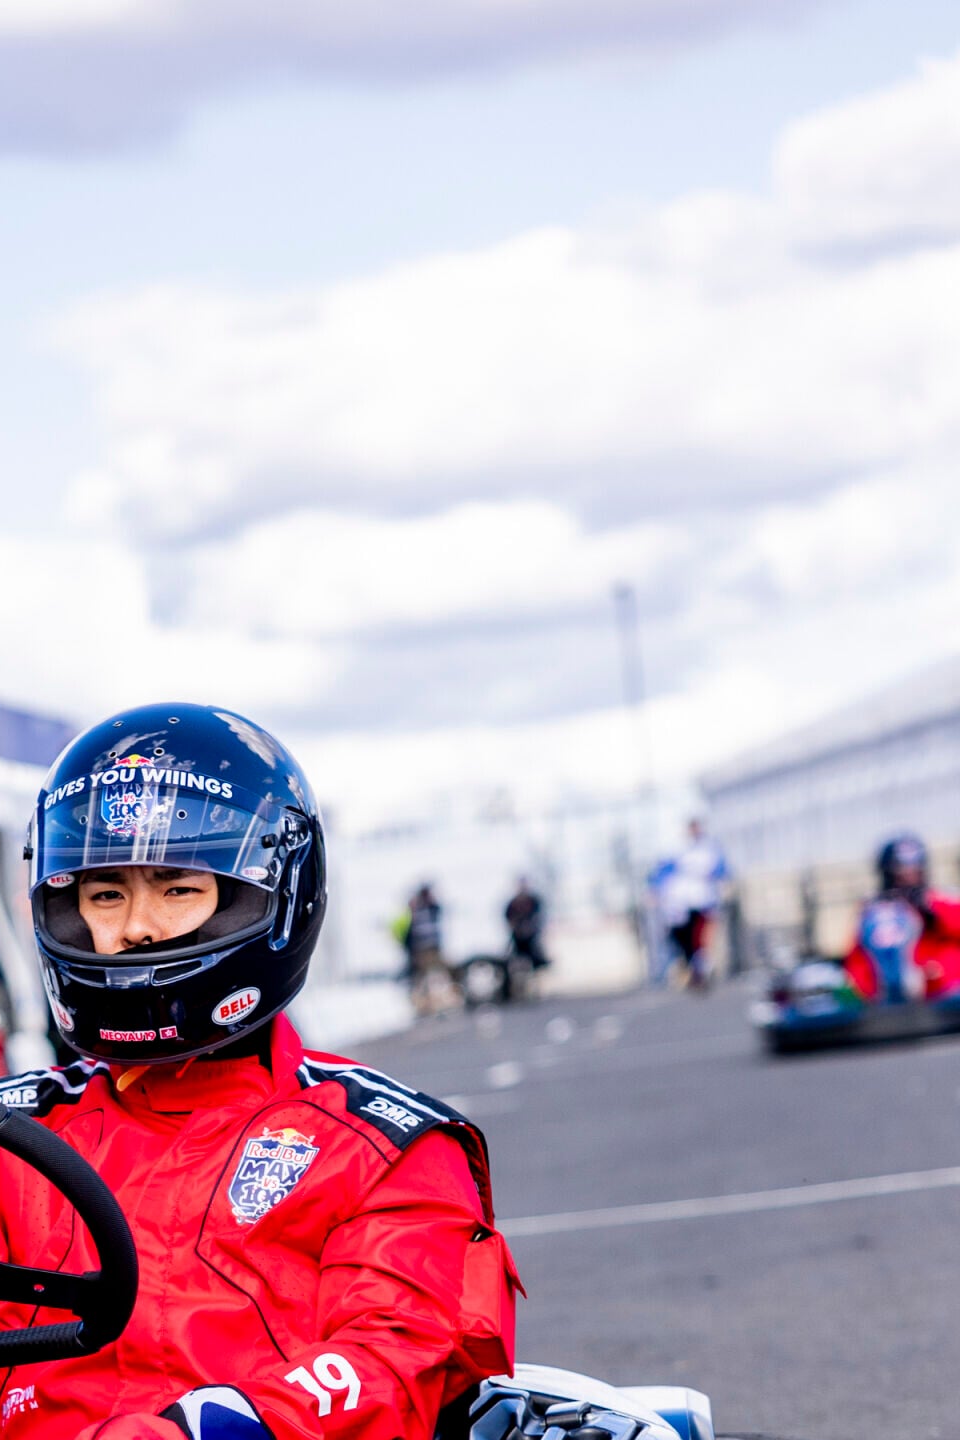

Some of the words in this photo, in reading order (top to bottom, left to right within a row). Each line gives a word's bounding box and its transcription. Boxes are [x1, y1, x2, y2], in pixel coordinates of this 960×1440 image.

[44, 777, 86, 810] GIVES
[90, 768, 136, 788] YOU
[141, 768, 233, 799] WIIINGS
[105, 784, 153, 802] MAX
[123, 793, 136, 804] VS
[109, 801, 148, 821] 100
[50, 876, 71, 884] BELL
[220, 993, 256, 1019] BELL
[367, 1100, 419, 1127] OMP
[248, 1142, 282, 1160] Red
[281, 1146, 315, 1164] Bull
[240, 1160, 307, 1187] MAX
[262, 1176, 279, 1189] VS
[241, 1183, 288, 1207] 100
[284, 1352, 362, 1417] 19
